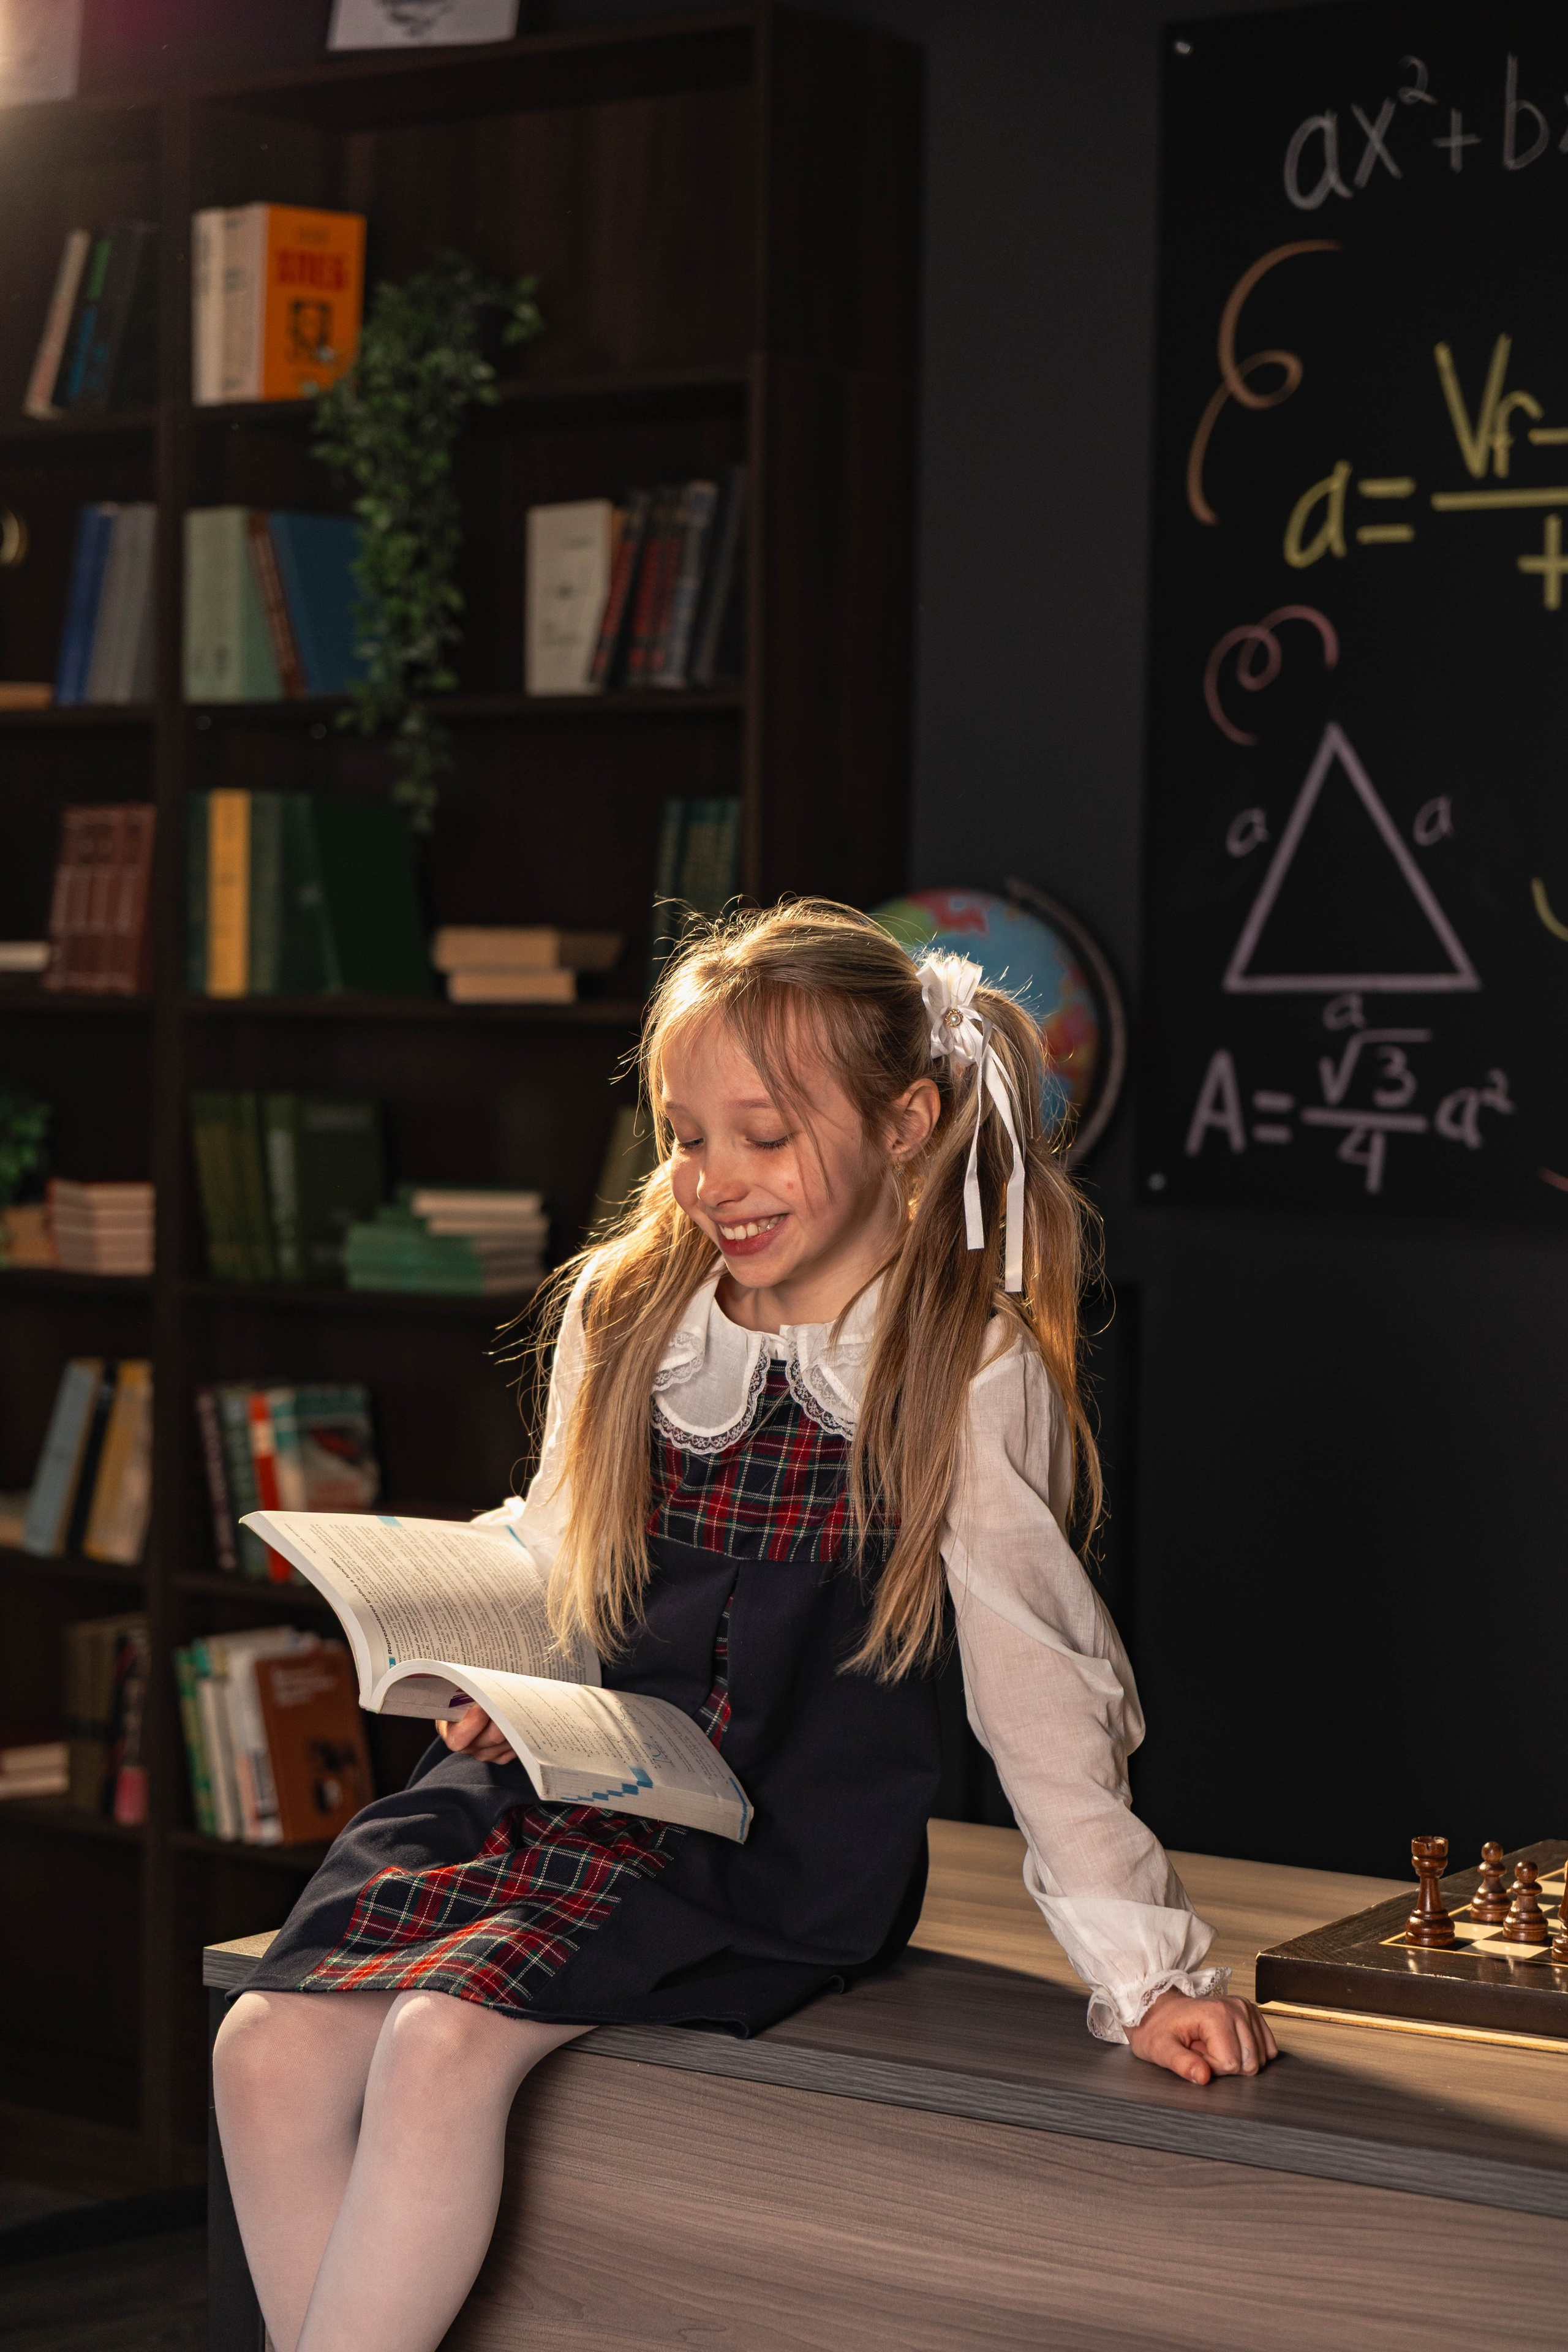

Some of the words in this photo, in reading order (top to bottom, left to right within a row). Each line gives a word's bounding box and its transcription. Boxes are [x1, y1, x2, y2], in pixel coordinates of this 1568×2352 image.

[1226, 807, 1269, 858] a
[1413, 793, 1454, 846] a
[1322, 991, 1367, 1031] a
[1337, 1127, 1389, 1196] 4
[352, 1584, 371, 1603] grafică
[368, 1605, 393, 1654] Reprezentarea
